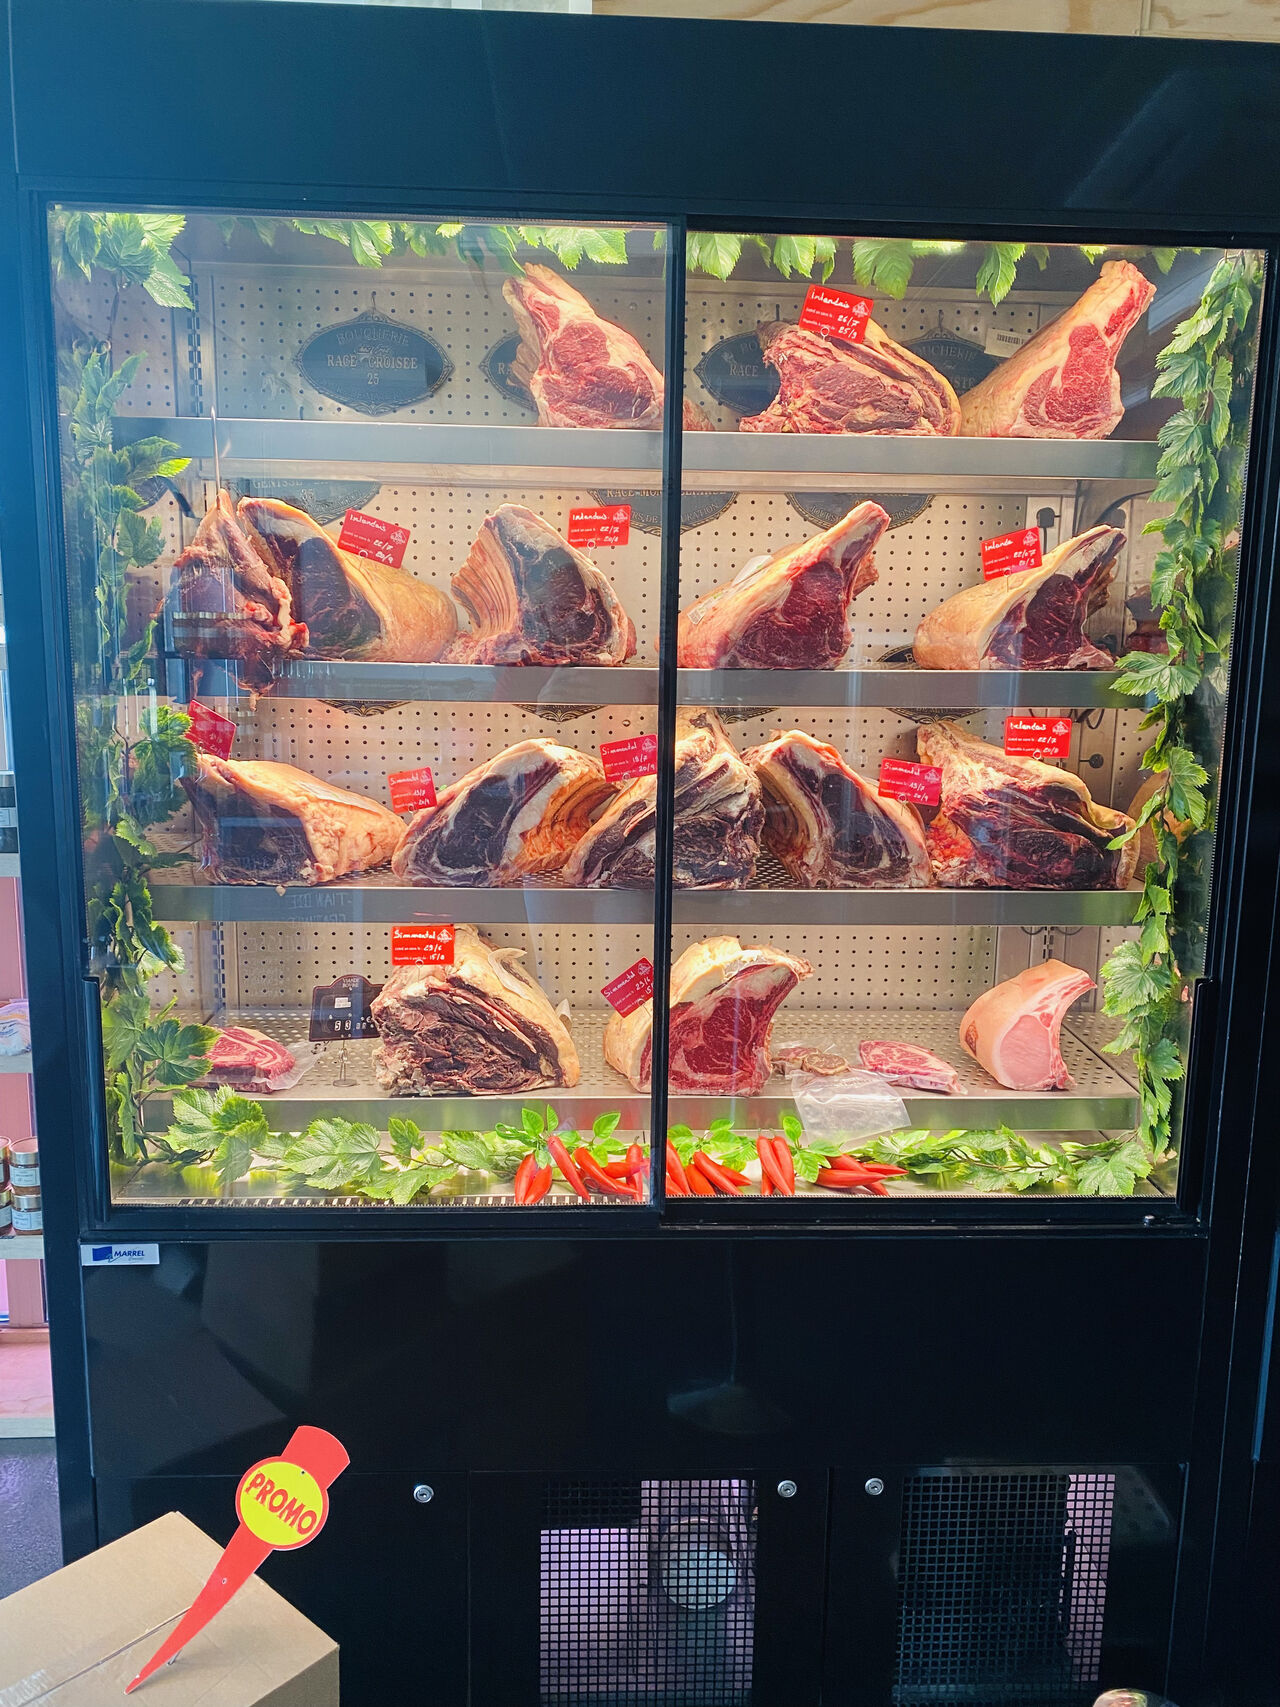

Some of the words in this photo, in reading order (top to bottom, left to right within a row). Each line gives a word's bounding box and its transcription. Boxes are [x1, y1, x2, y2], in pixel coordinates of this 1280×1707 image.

[327, 354, 357, 367] RACE
[729, 364, 759, 377] RACE
[367, 372, 379, 385] 25
[393, 929, 436, 939] Simmental
[244, 1470, 318, 1535] PROMO
